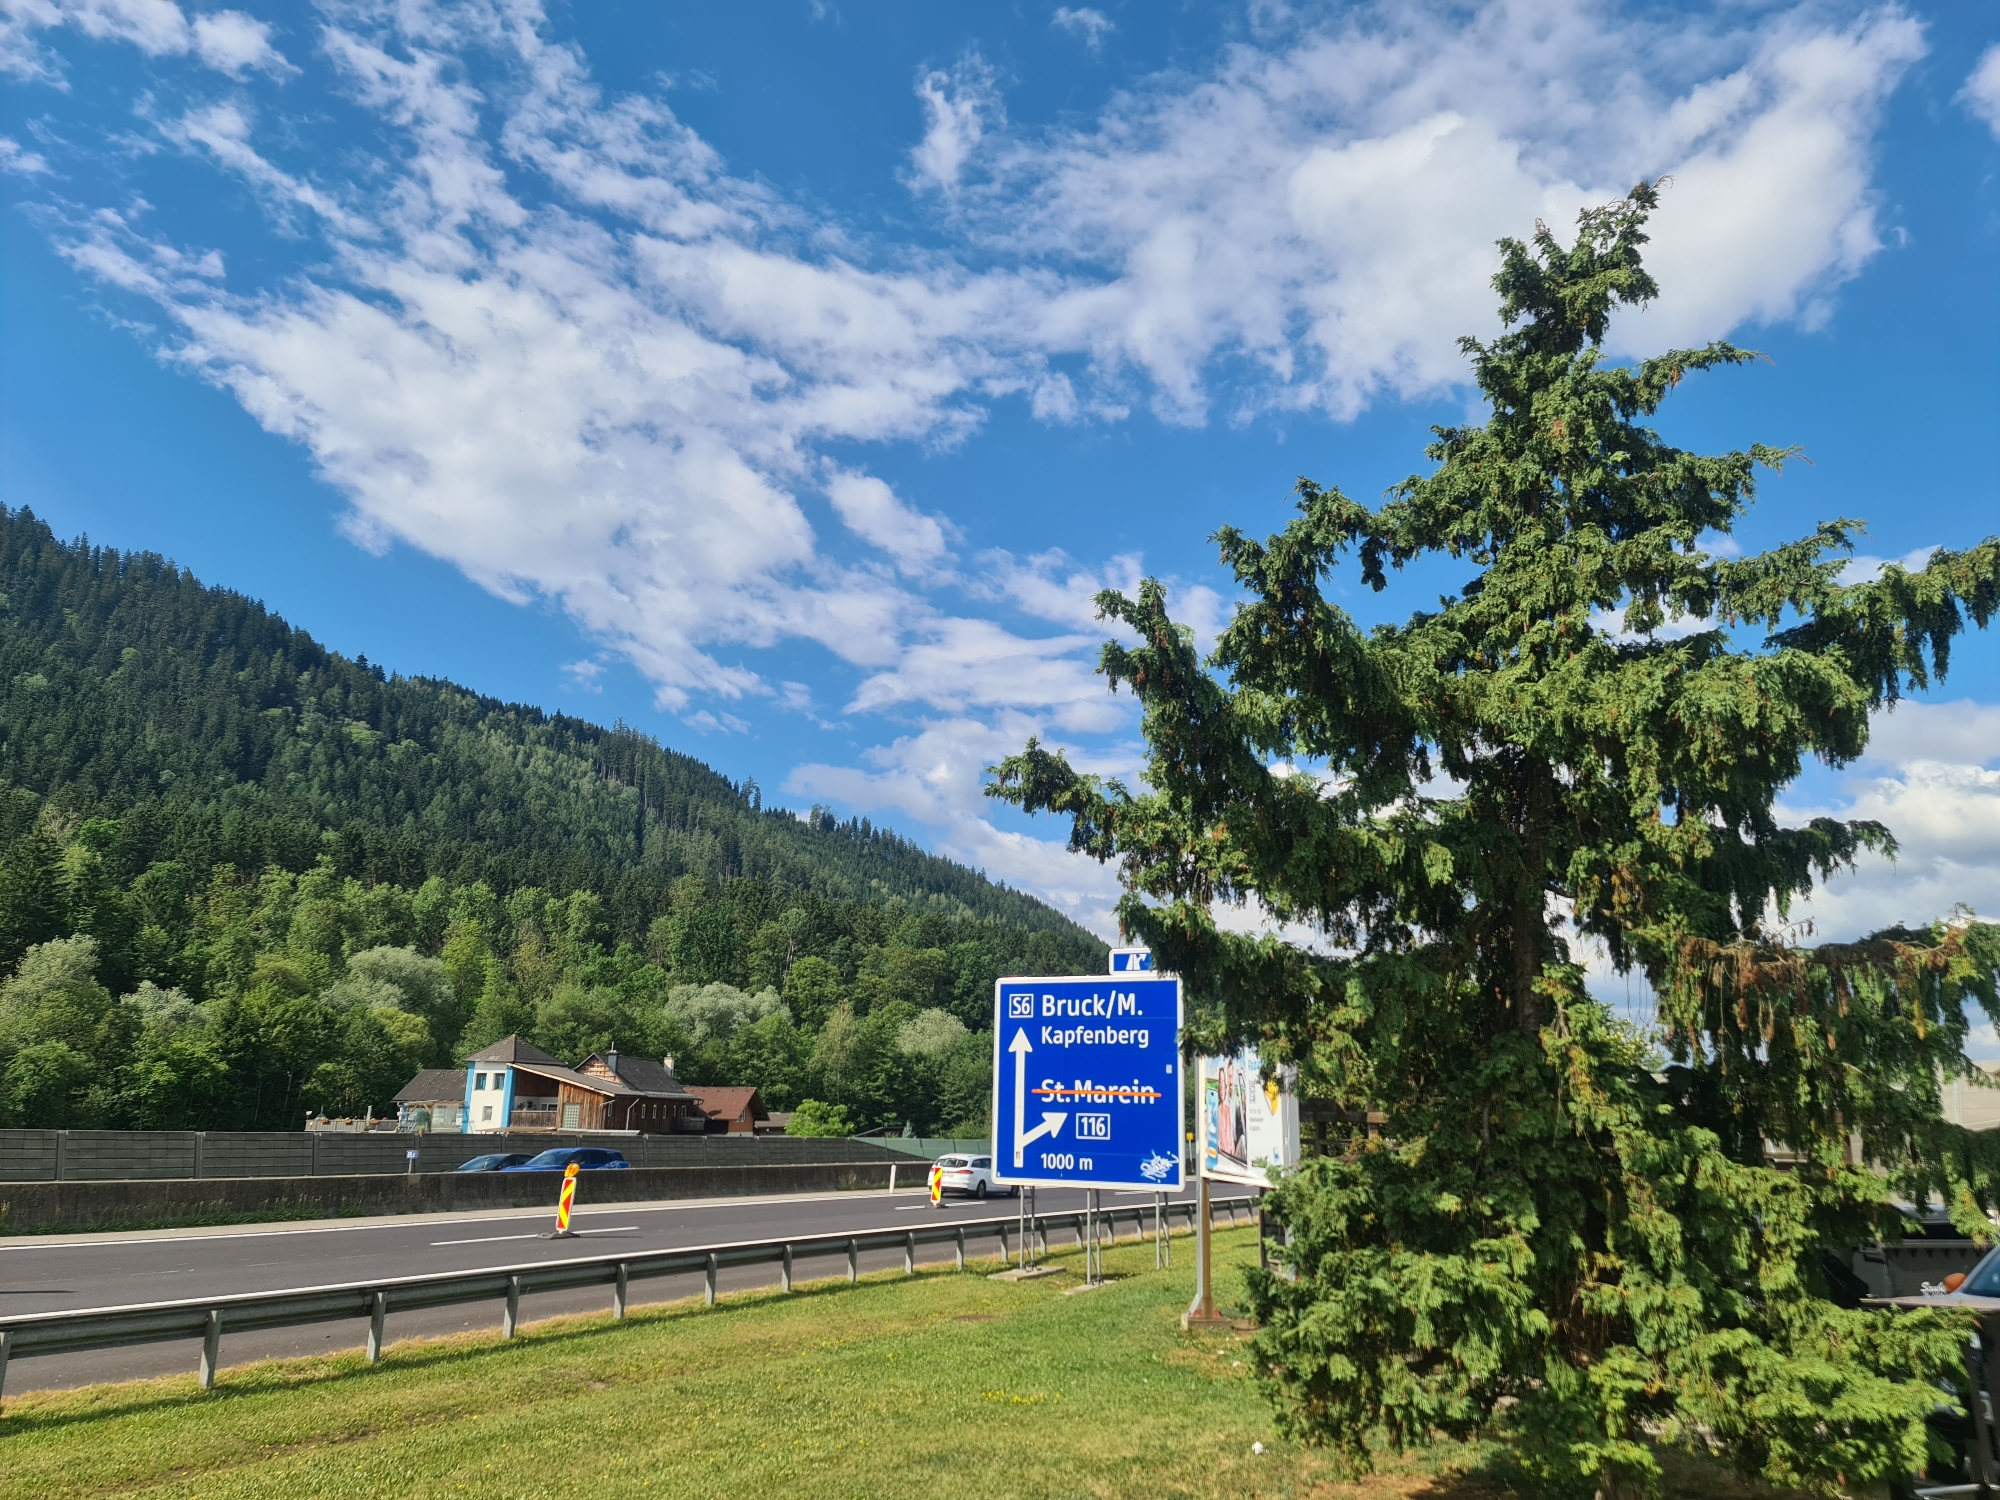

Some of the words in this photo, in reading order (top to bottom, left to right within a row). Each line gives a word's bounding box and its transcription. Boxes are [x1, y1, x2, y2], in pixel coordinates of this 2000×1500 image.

[1012, 996, 1031, 1015] S6
[1042, 990, 1143, 1019] Bruck/M.
[1041, 1025, 1149, 1049] Kapfenberg
[1081, 1116, 1106, 1136] 116
[1041, 1153, 1074, 1170] 1000
[1079, 1156, 1093, 1170] m
